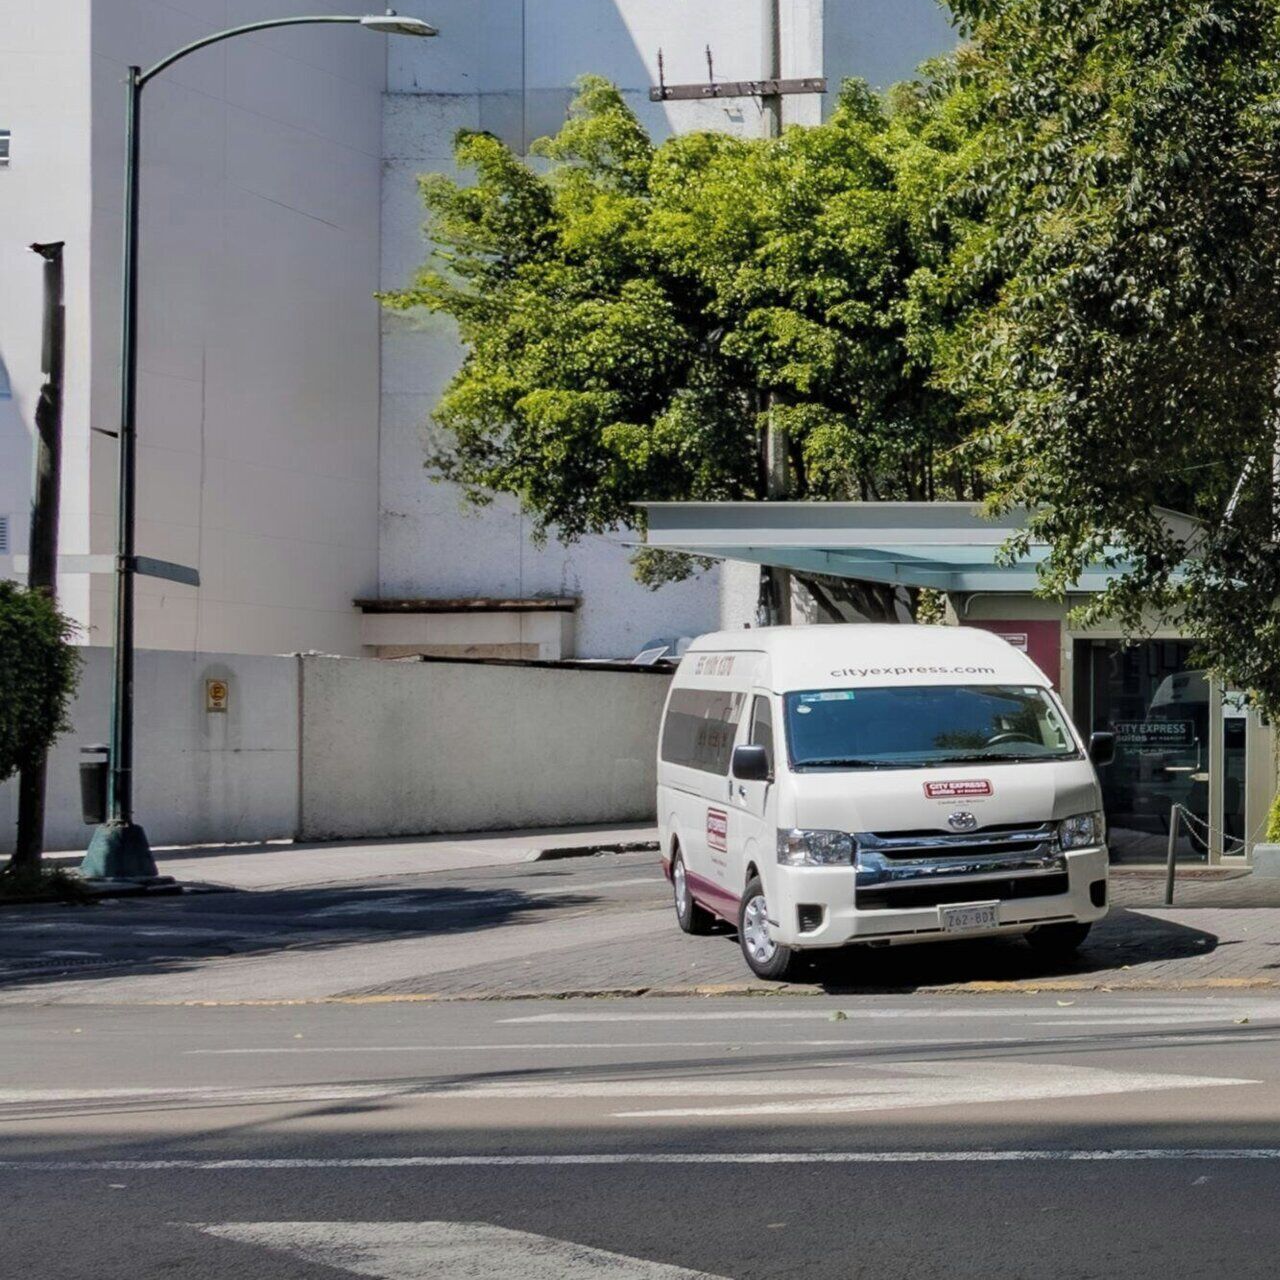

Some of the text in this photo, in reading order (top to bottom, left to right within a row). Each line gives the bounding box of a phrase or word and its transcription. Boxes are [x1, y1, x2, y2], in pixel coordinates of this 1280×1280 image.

[830, 666, 996, 677] cityexpress.com
[1114, 723, 1186, 733] CITY EXPRESS
